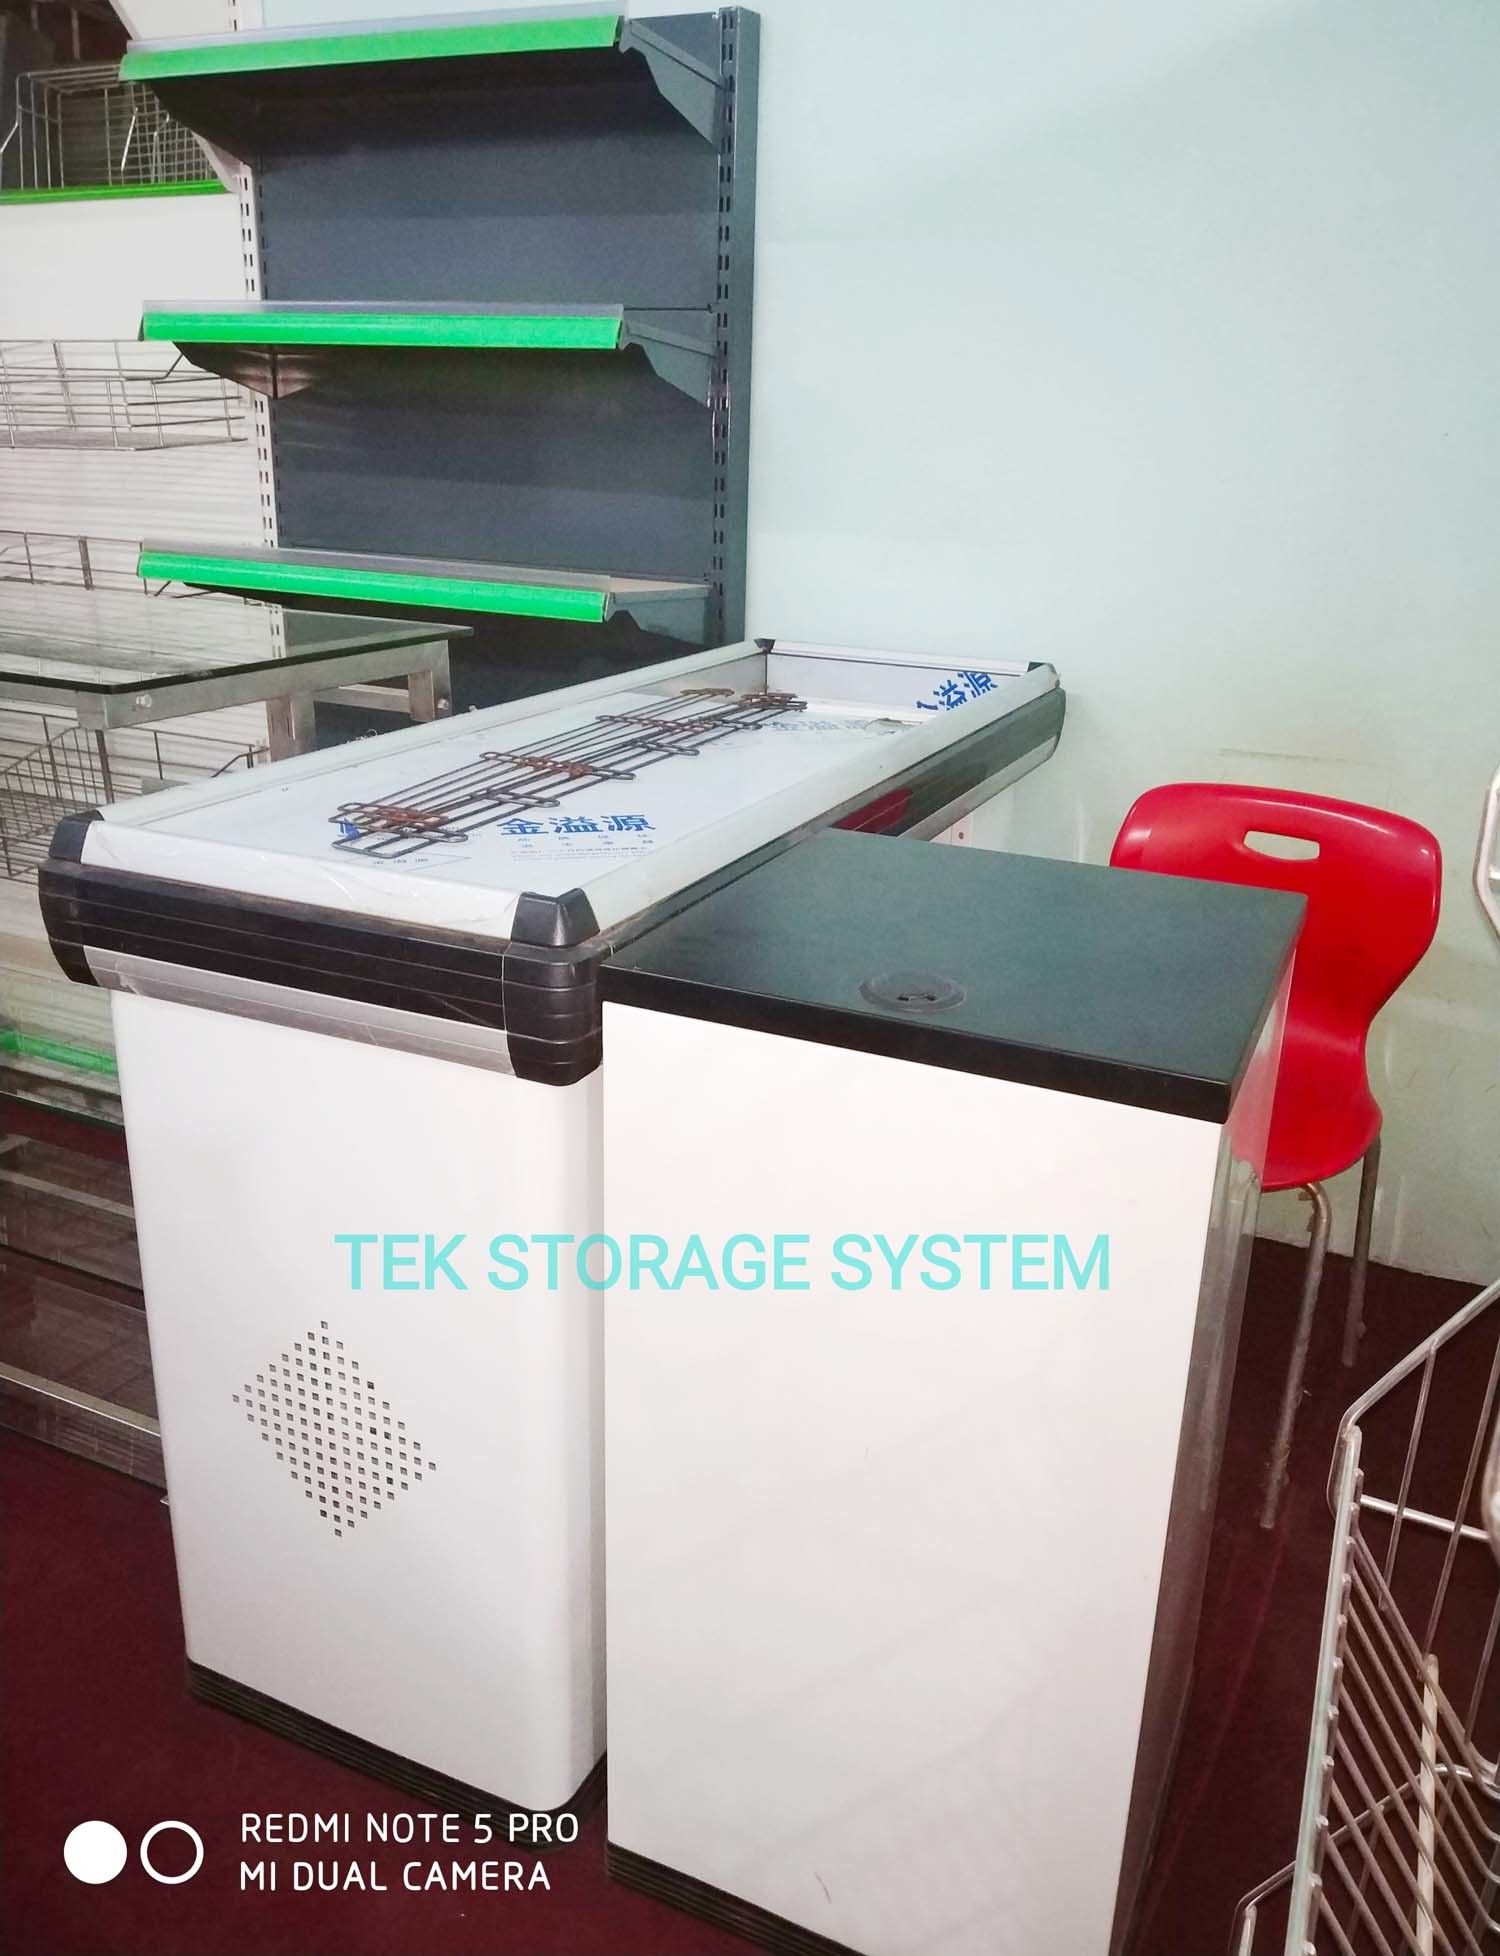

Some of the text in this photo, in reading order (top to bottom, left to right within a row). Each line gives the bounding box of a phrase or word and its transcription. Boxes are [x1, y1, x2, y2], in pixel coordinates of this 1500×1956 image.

[916, 671, 998, 711] 溢源
[497, 814, 656, 836] 金溢源
